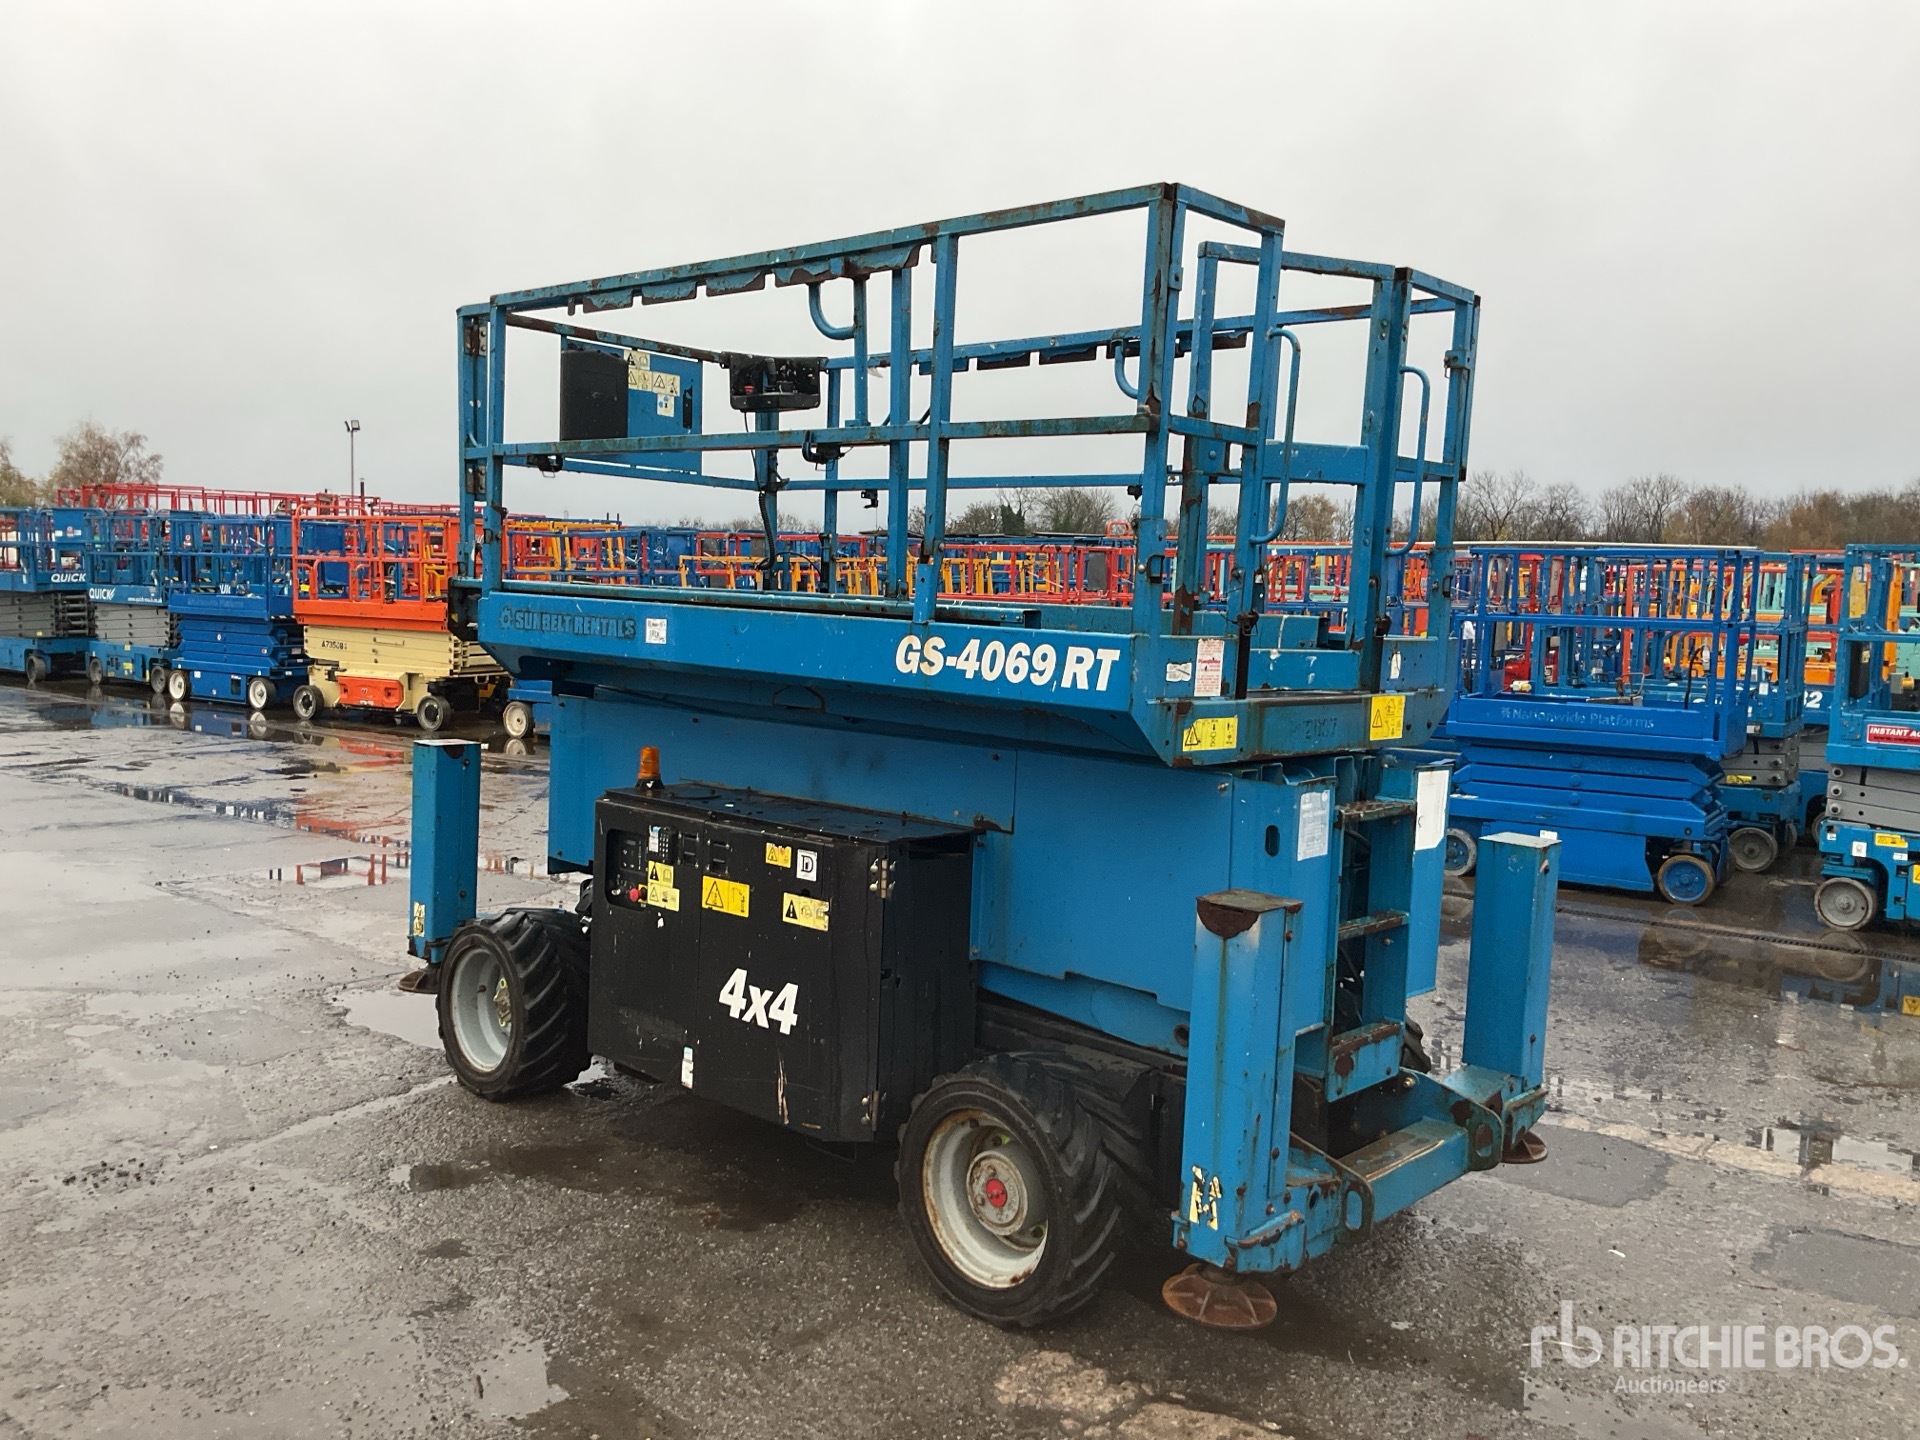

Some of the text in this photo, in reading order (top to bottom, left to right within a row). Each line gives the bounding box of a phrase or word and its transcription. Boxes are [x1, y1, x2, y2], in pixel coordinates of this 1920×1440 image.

[51, 573, 87, 583] QUICK
[89, 588, 115, 600] QUICK
[515, 611, 572, 633] SUNBELT
[574, 616, 636, 639] RENTALS
[895, 634, 1121, 691] GS-4069 RT
[1512, 709, 1654, 729] Nationwide Platforms
[1869, 727, 1910, 737] INSTANT
[718, 968, 798, 1035] 4x4
